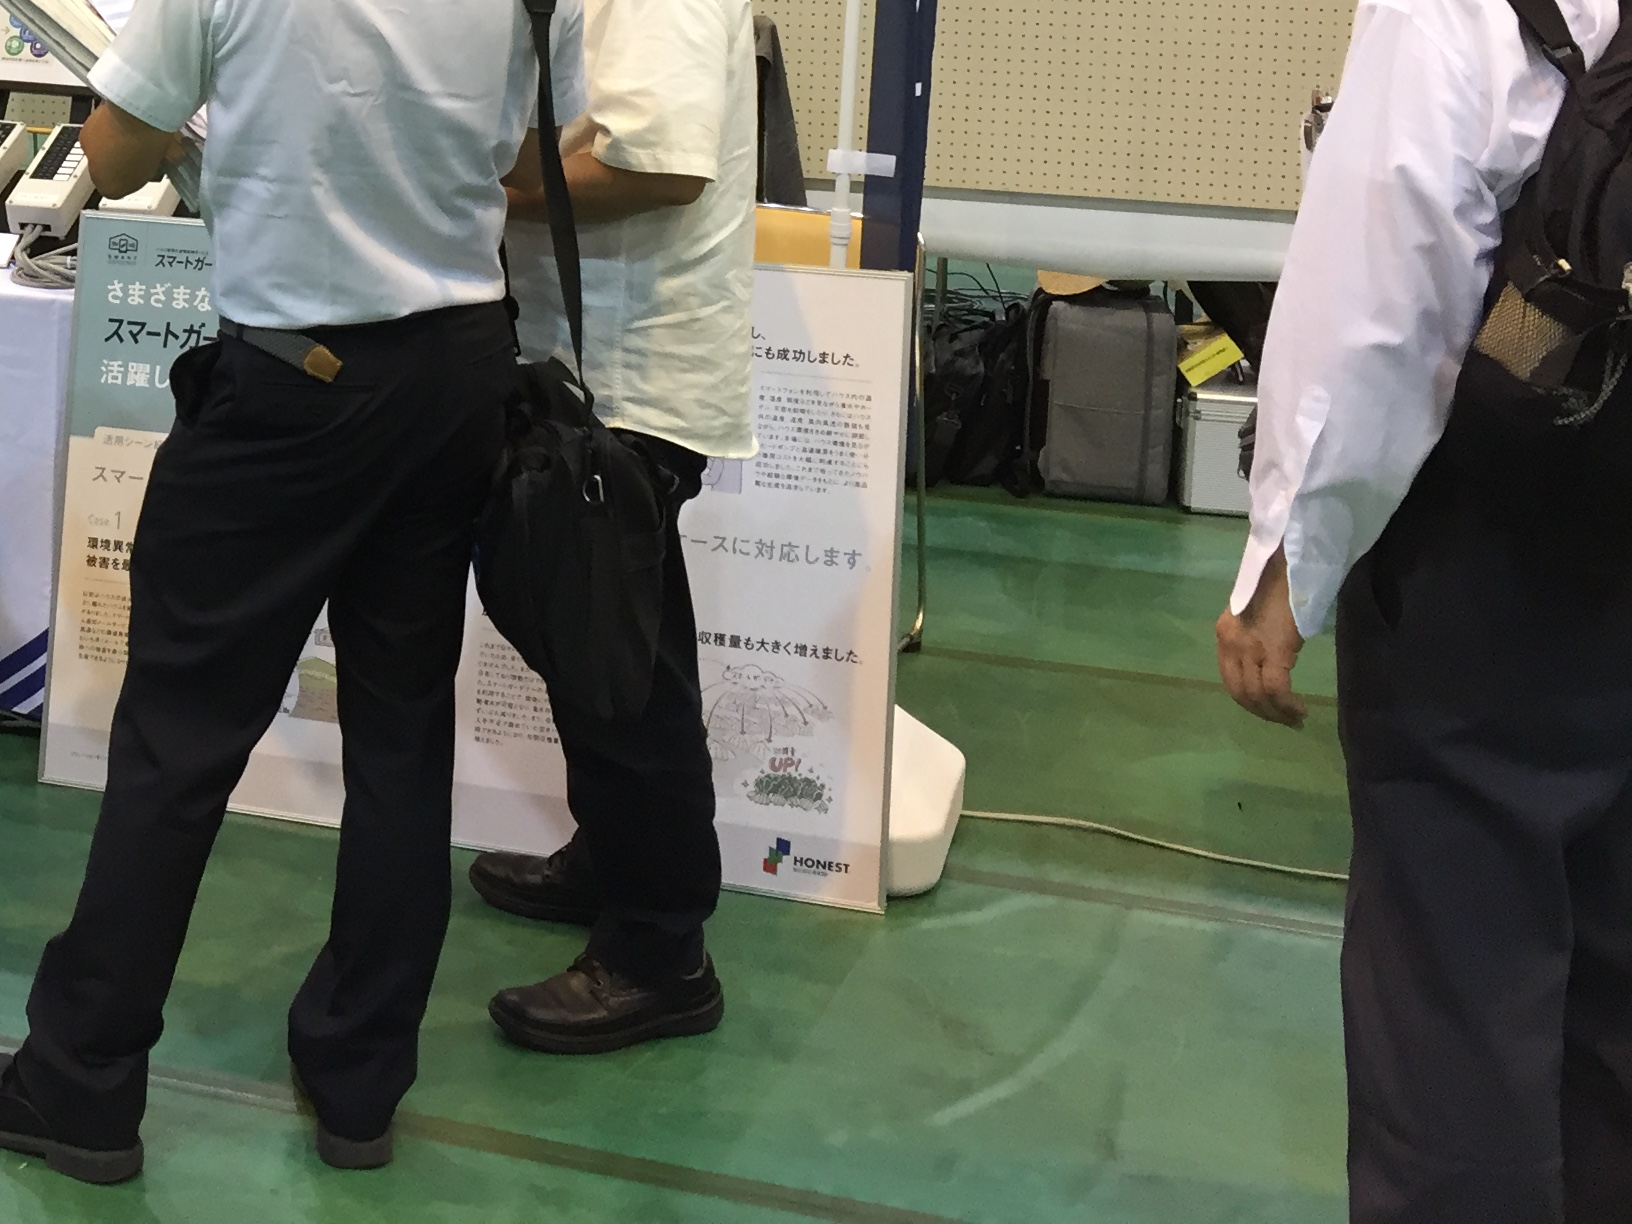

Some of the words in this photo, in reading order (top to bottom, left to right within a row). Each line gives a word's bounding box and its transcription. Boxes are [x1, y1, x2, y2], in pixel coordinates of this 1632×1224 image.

[155, 254, 213, 271] スマートガー
[107, 280, 212, 312] さまざまな
[100, 359, 170, 389] 活躍し
[114, 511, 121, 530] 1
[698, 630, 863, 665] 収穫量も大きく増えました。
[793, 855, 850, 874] HONEST
